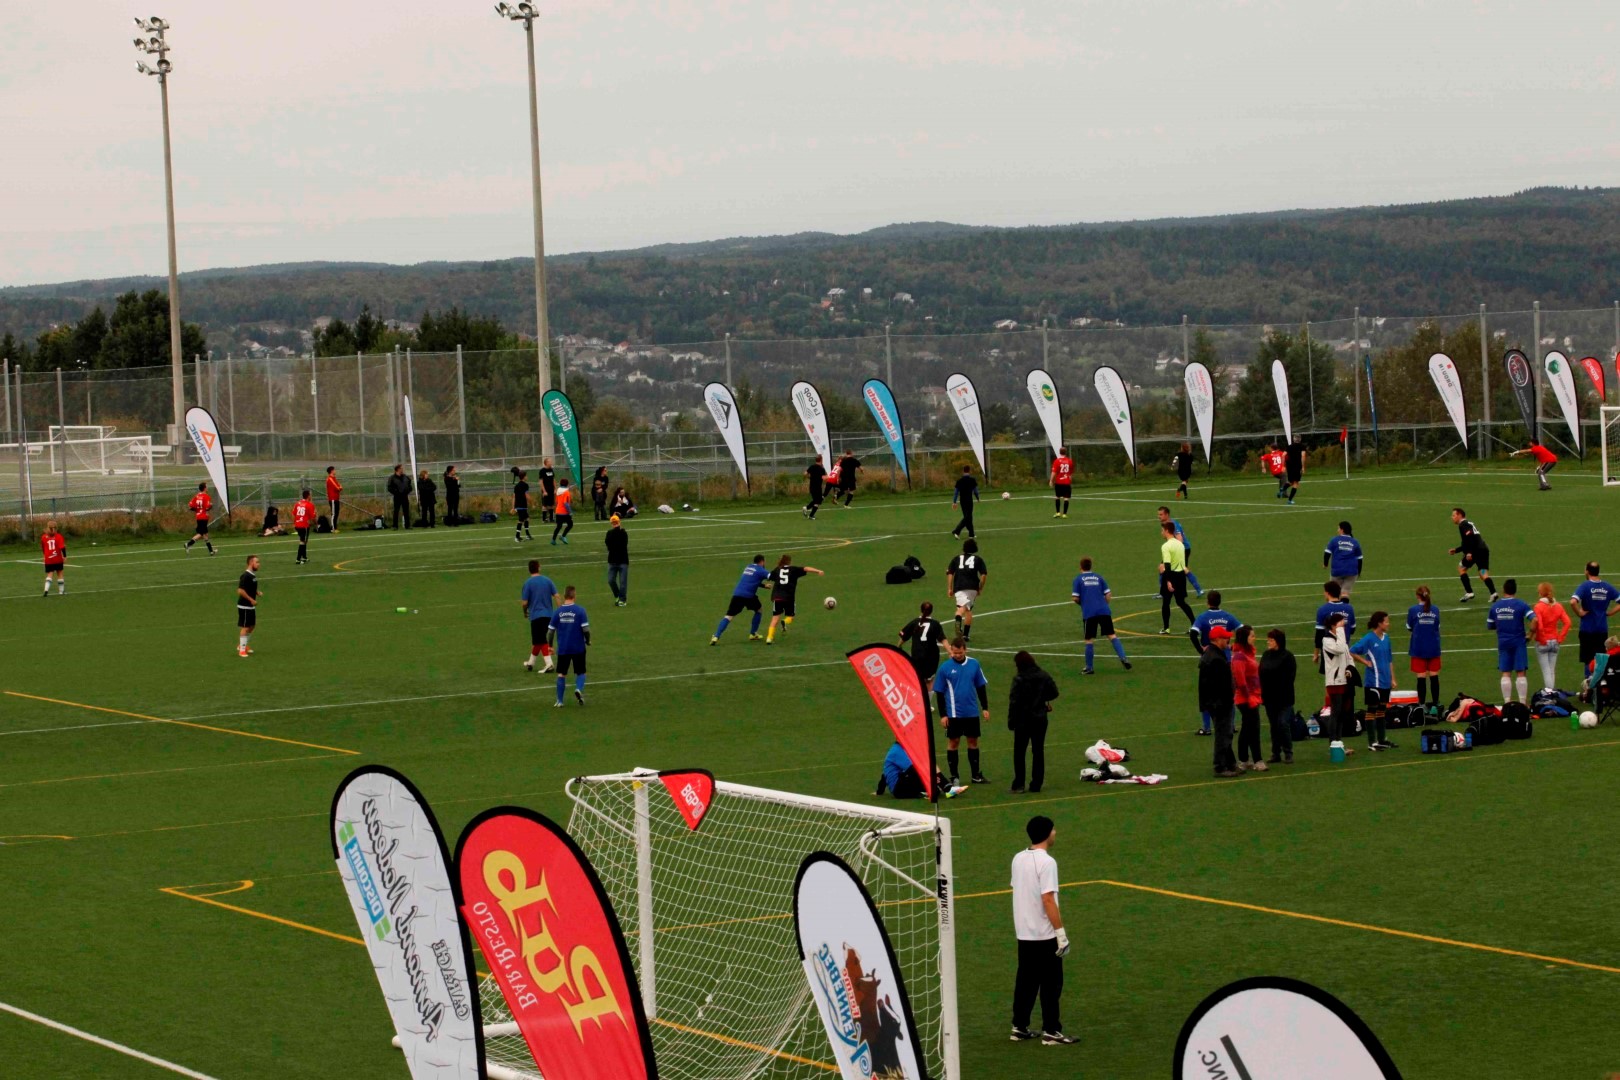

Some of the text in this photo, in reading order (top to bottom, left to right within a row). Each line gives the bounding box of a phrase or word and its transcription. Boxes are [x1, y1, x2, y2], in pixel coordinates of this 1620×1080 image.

[1059, 463, 1070, 474] 23
[296, 506, 306, 517] 26
[958, 554, 976, 569] 14
[778, 568, 789, 585] 5
[1495, 606, 1515, 614] Grenier
[1208, 617, 1229, 625] Grenier
[918, 622, 930, 641] 7
[681, 783, 700, 806] BGP
